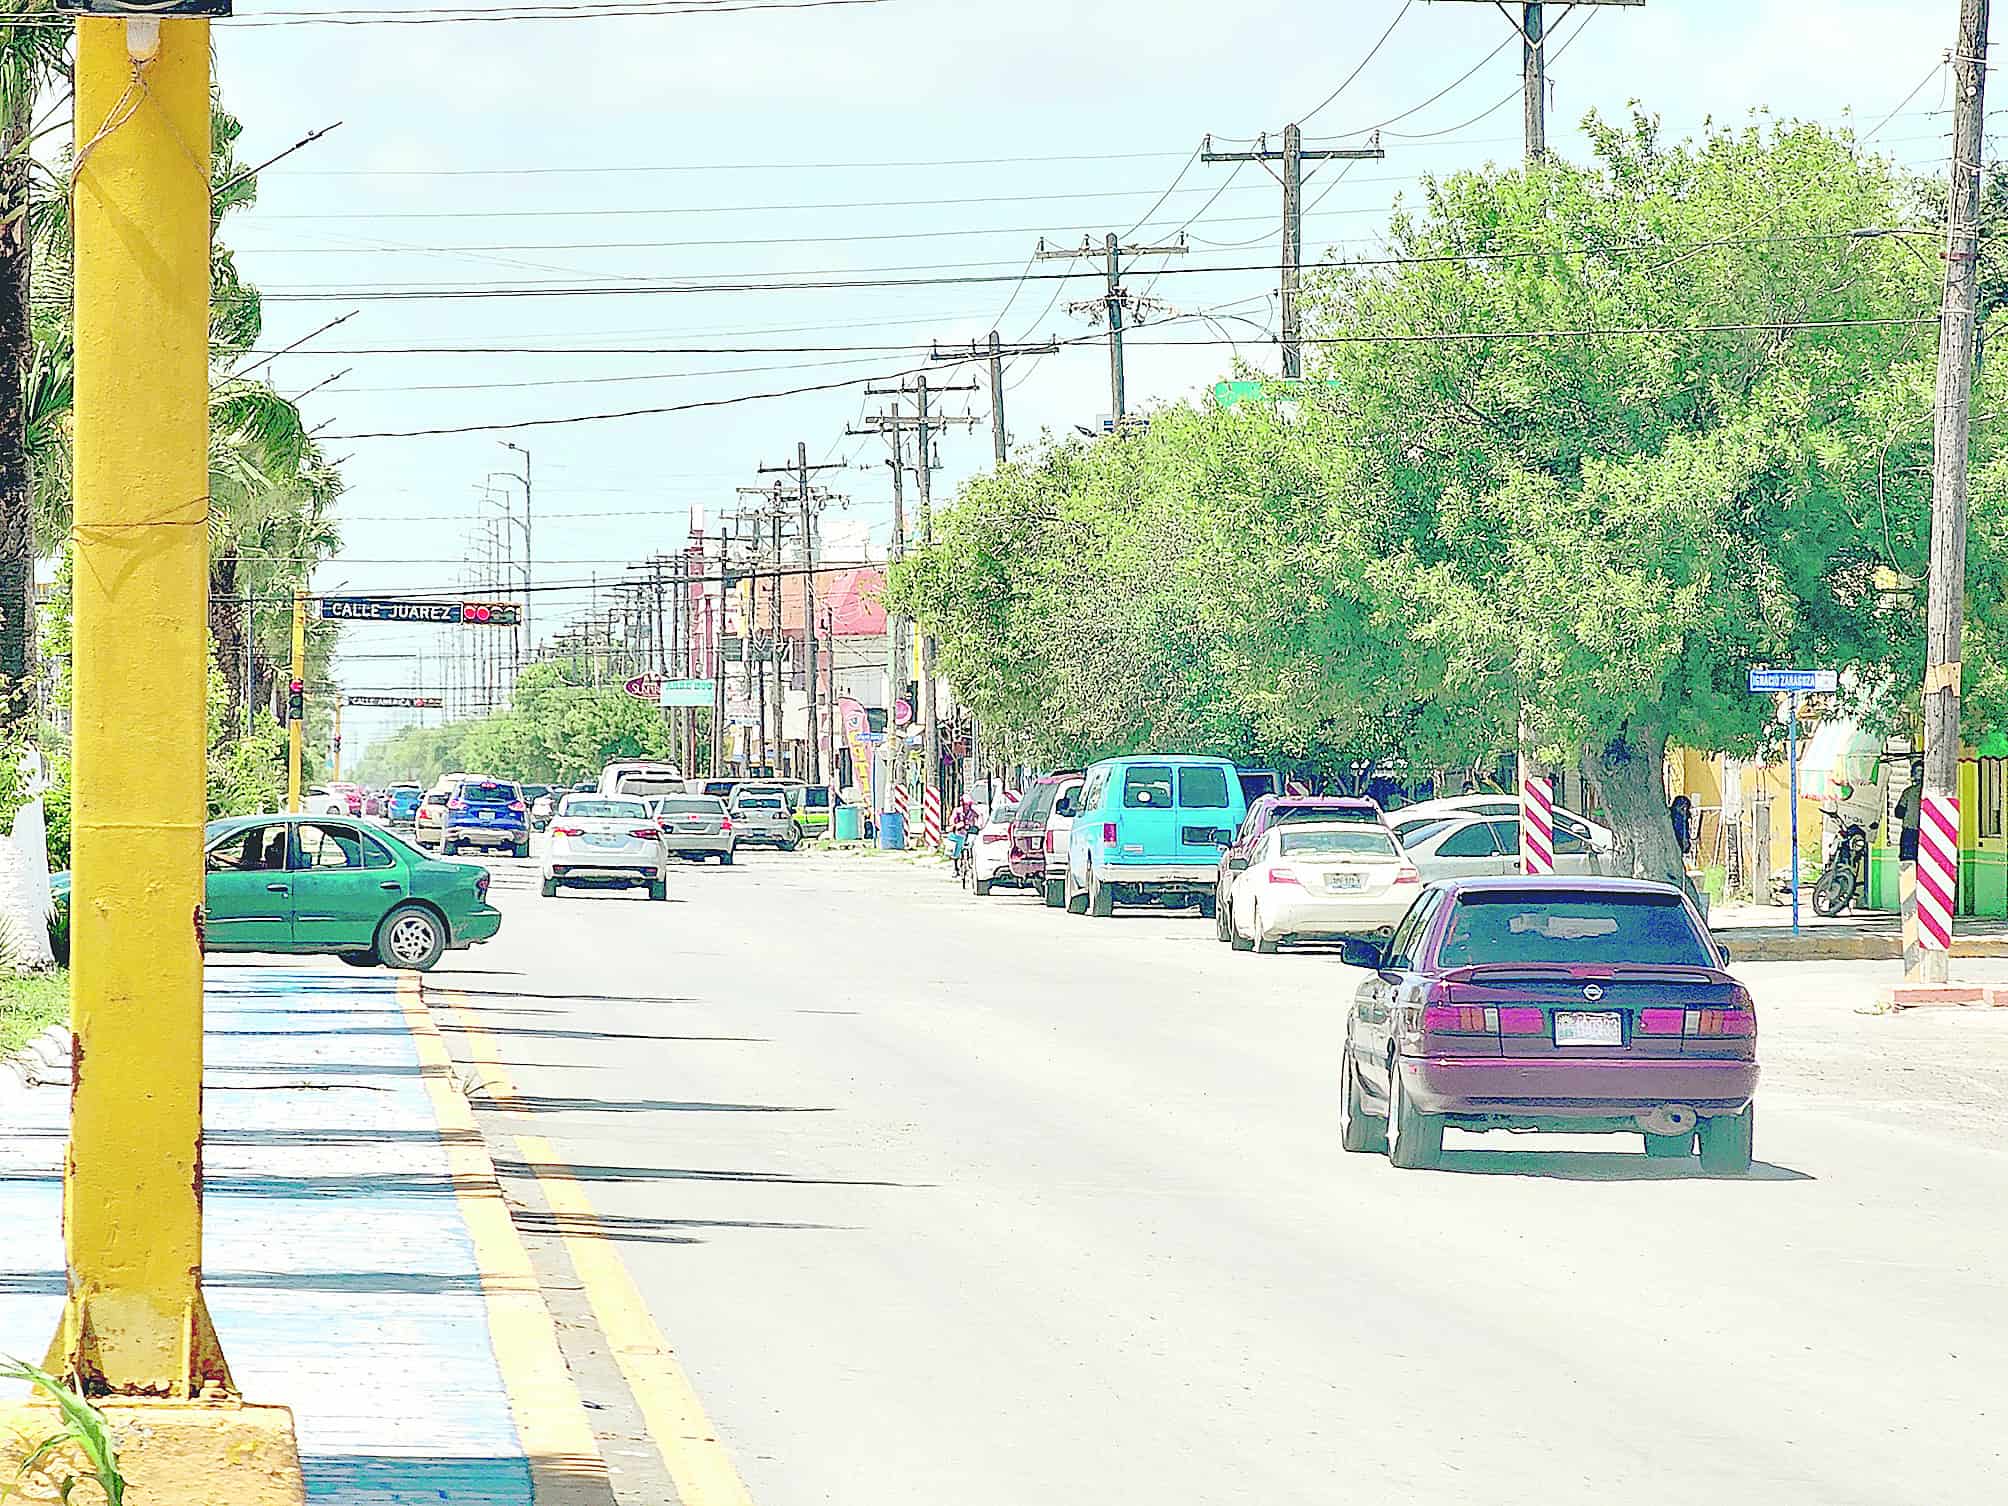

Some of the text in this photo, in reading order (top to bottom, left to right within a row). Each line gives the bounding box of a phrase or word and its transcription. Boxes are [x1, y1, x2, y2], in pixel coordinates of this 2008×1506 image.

[332, 604, 451, 620] CALLE JUAREZ
[352, 697, 376, 705] CALLE
